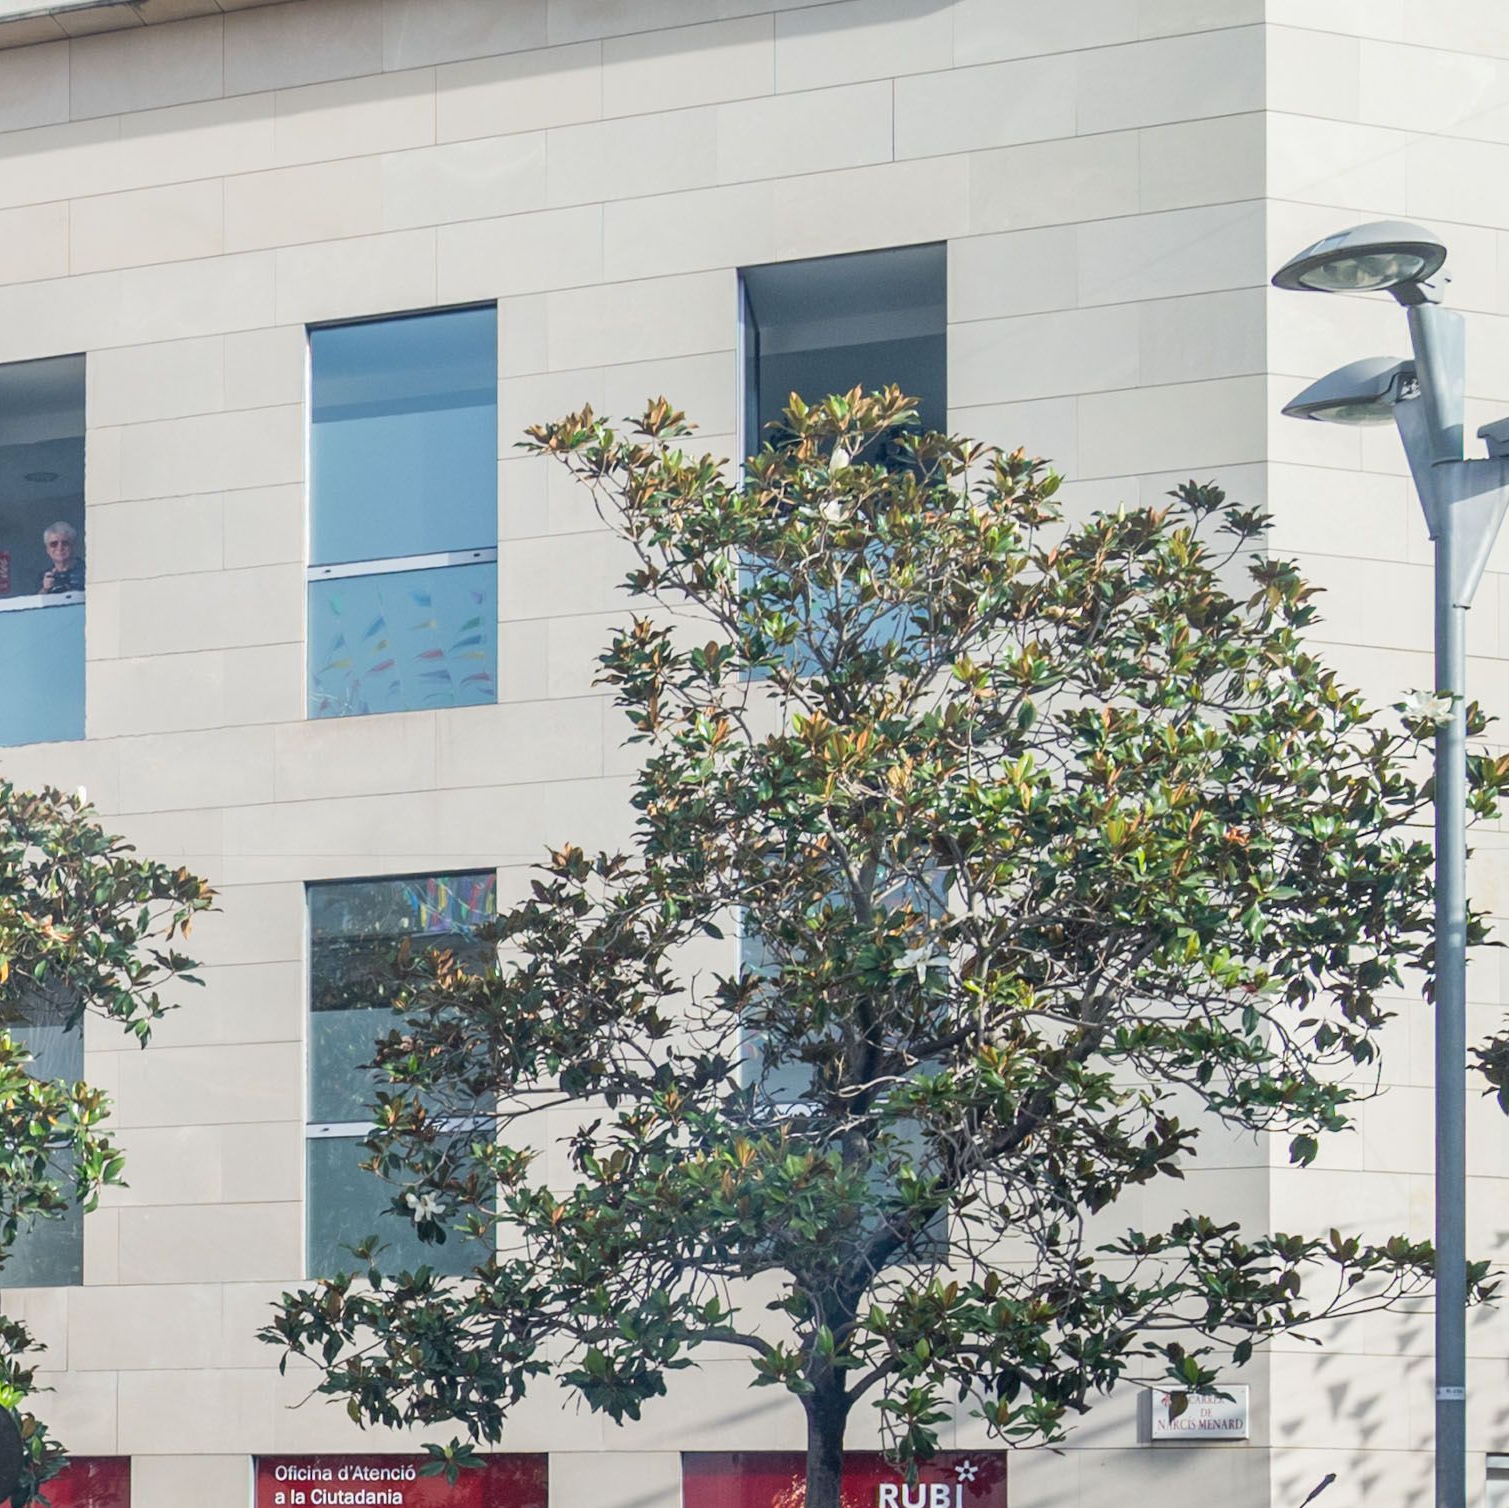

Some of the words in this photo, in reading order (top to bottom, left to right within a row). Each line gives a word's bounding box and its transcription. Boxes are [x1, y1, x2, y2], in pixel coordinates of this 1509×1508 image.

[1200, 1408, 1213, 1417] DE
[1198, 1418, 1243, 1430] MENARD
[274, 1465, 332, 1481] Oficina
[337, 1463, 416, 1482] d'Atenció
[274, 1492, 285, 1505] a
[290, 1488, 306, 1505] la
[310, 1489, 403, 1505] Ciutadania
